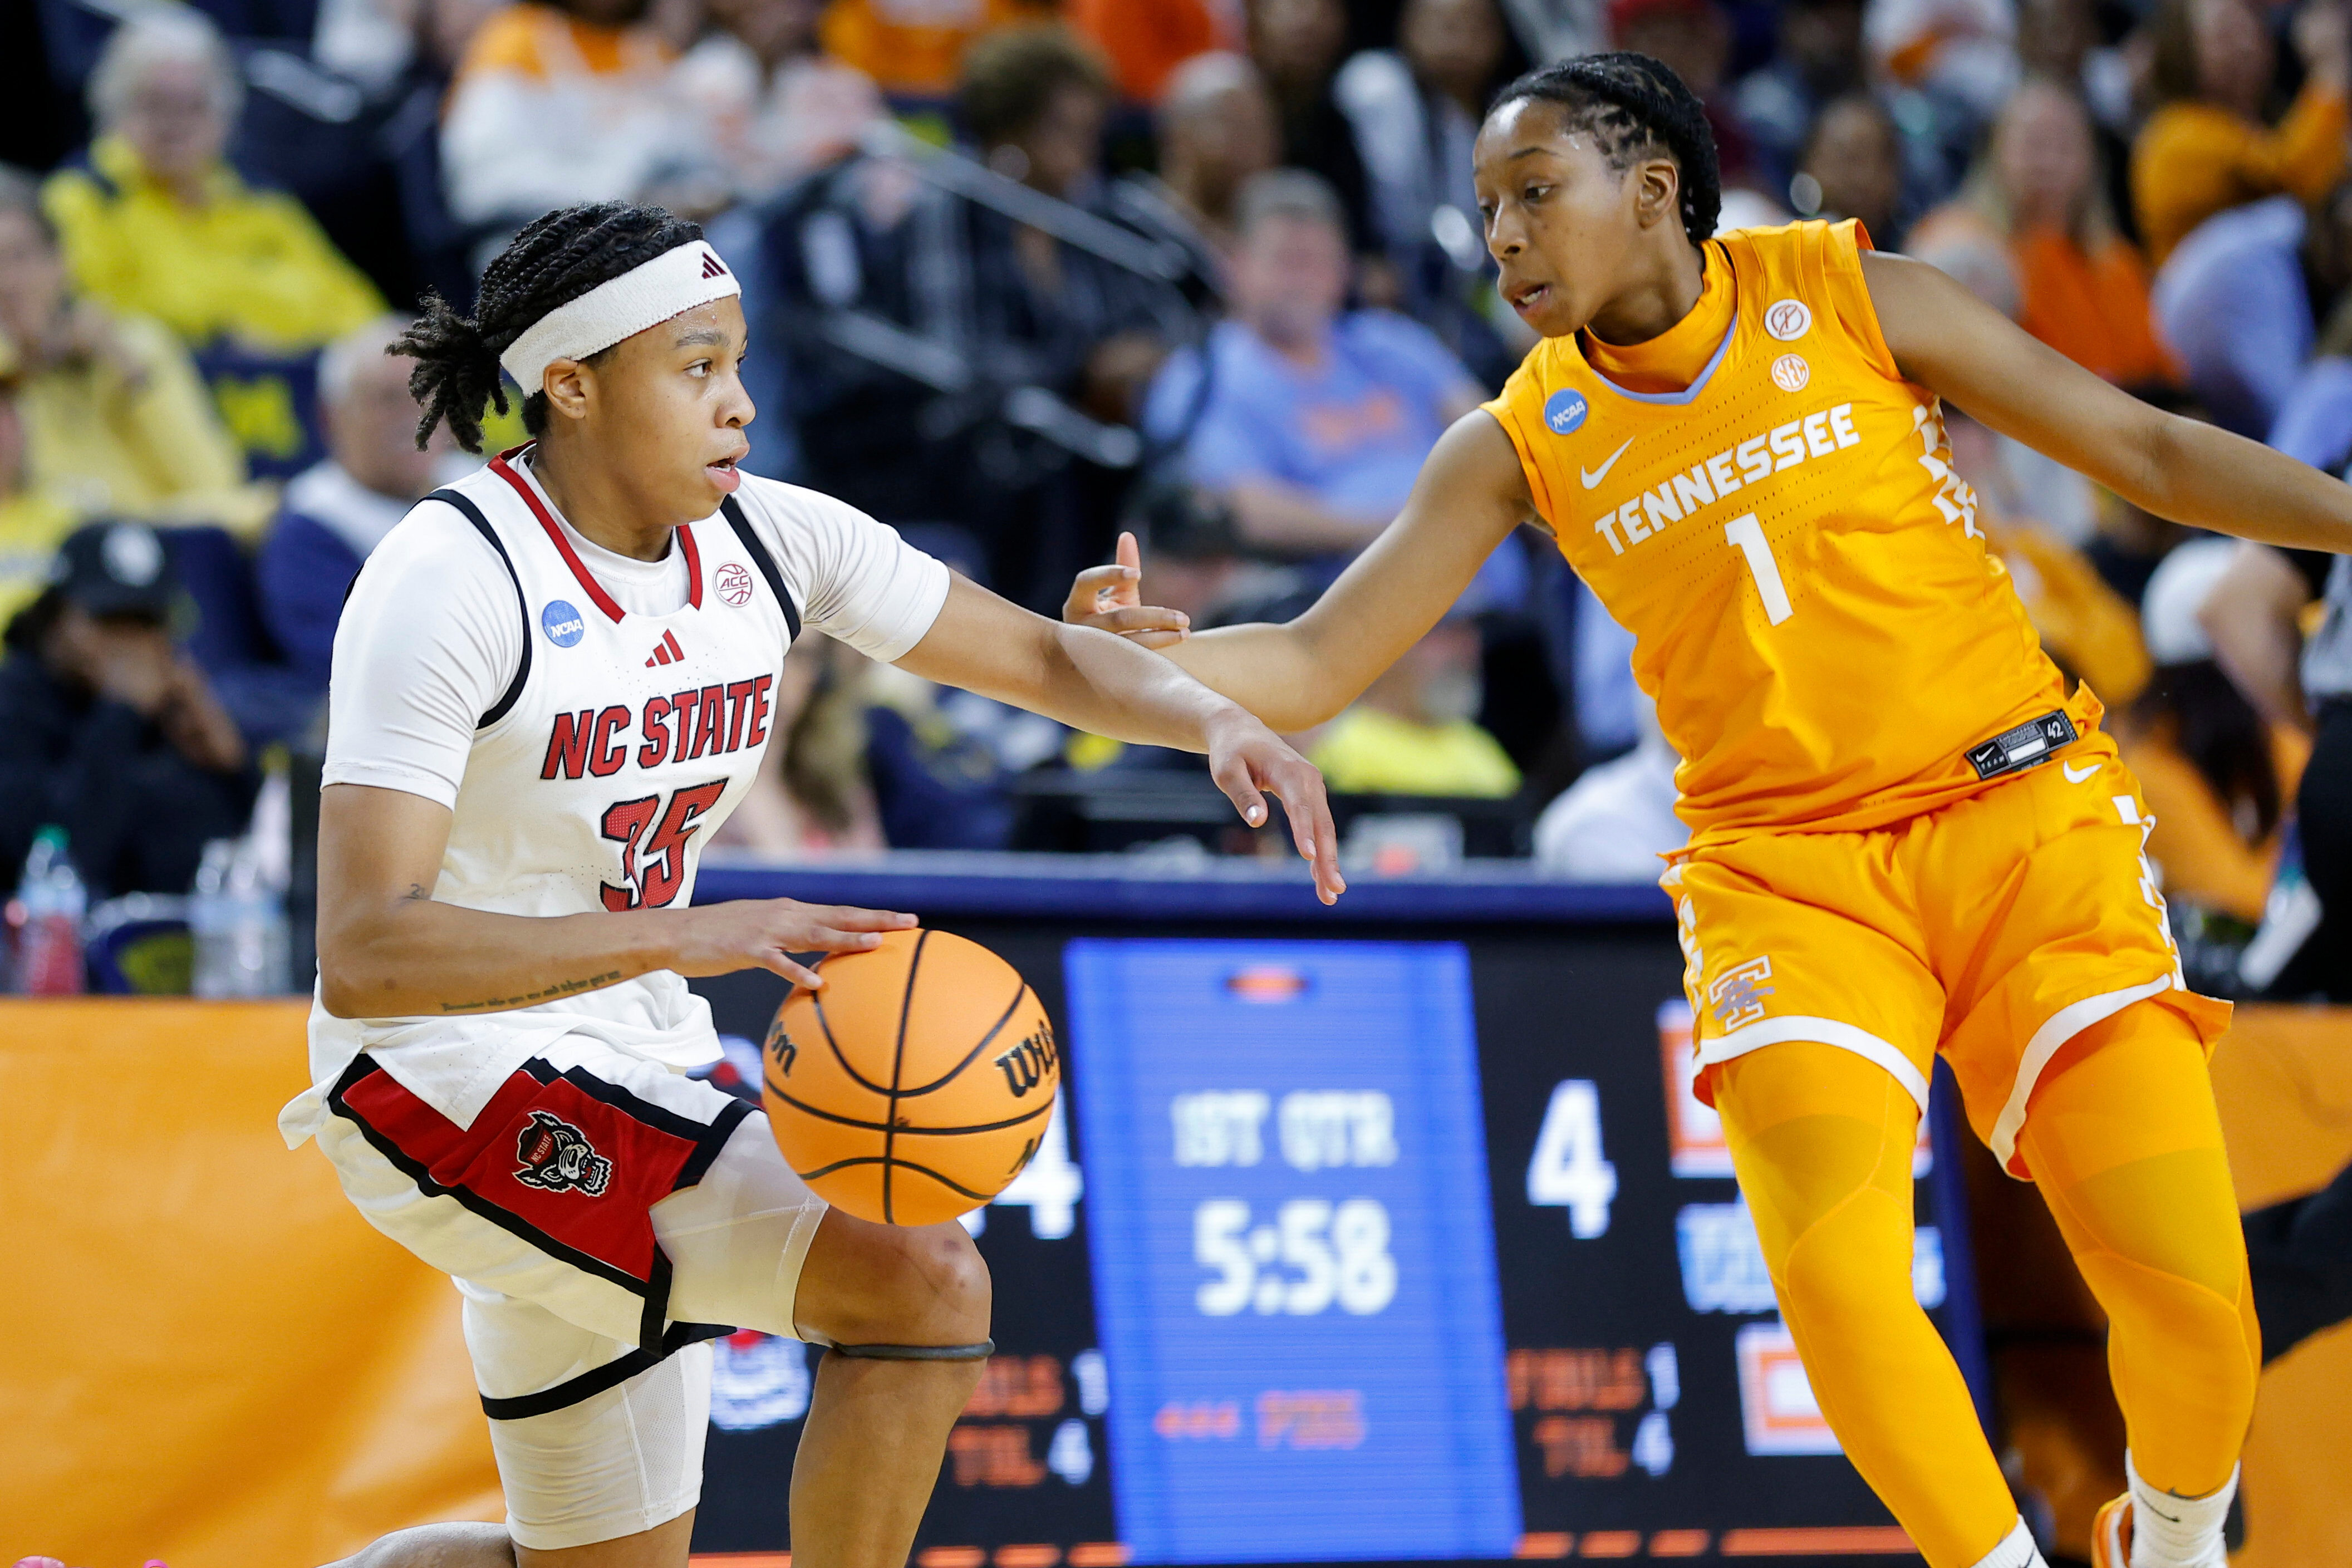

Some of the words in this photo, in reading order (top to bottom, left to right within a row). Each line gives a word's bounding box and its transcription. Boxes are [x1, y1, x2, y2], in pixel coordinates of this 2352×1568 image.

[1775, 357, 1806, 388] SEC
[1552, 400, 1586, 429] NCAA
[1594, 402, 1861, 556] TENNESSEE
[720, 574, 749, 589] ACC
[1724, 511, 1794, 627] 1
[550, 619, 583, 638] NCAA
[540, 705, 631, 779] NC
[637, 674, 773, 769] STATE
[2046, 720, 2065, 739] 42
[600, 778, 729, 913] 35
[531, 1153, 541, 1162] NC
[538, 1134, 552, 1154] STATE
[1171, 1089, 1270, 1168] 1ST
[1279, 1089, 1400, 1172] QTR
[1526, 1078, 1619, 1240] 4
[1194, 1198, 1398, 1316] 5:58
